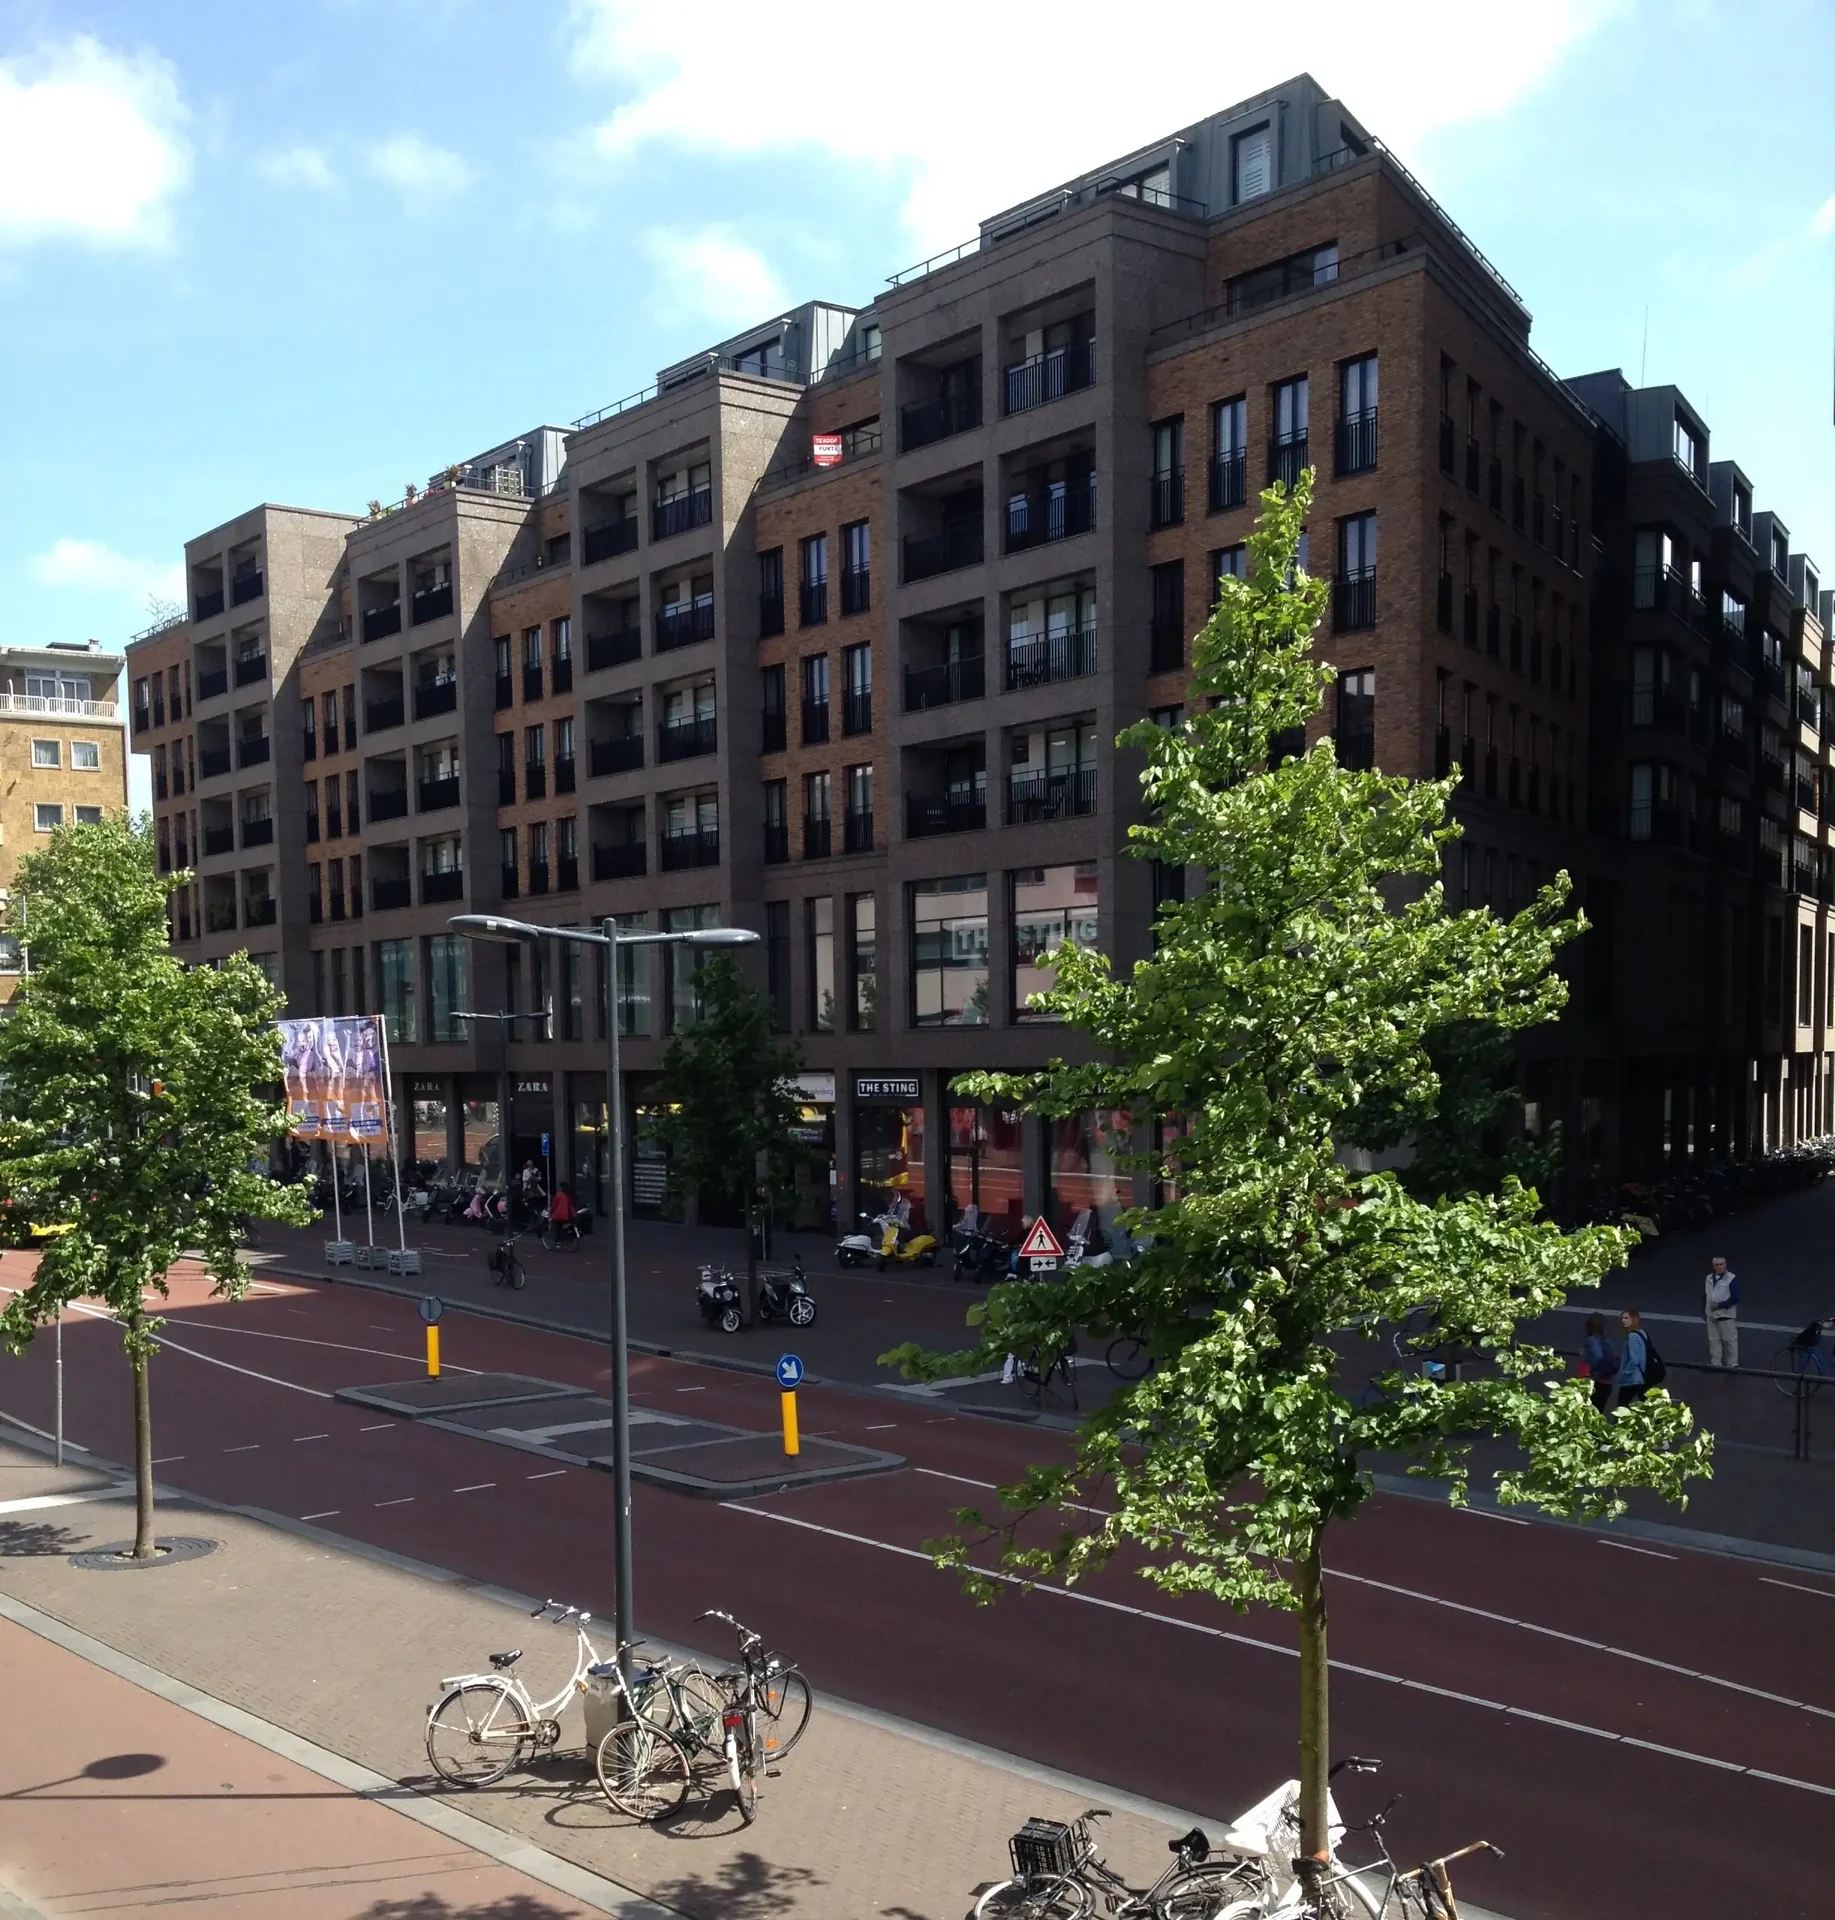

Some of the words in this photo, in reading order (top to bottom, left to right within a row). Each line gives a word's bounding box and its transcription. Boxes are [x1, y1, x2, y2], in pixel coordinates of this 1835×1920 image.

[958, 927, 989, 950] TH
[414, 1082, 440, 1091] ZARA
[518, 1082, 549, 1092] ZARA
[860, 1083, 880, 1093] THE
[882, 1083, 916, 1093] STING
